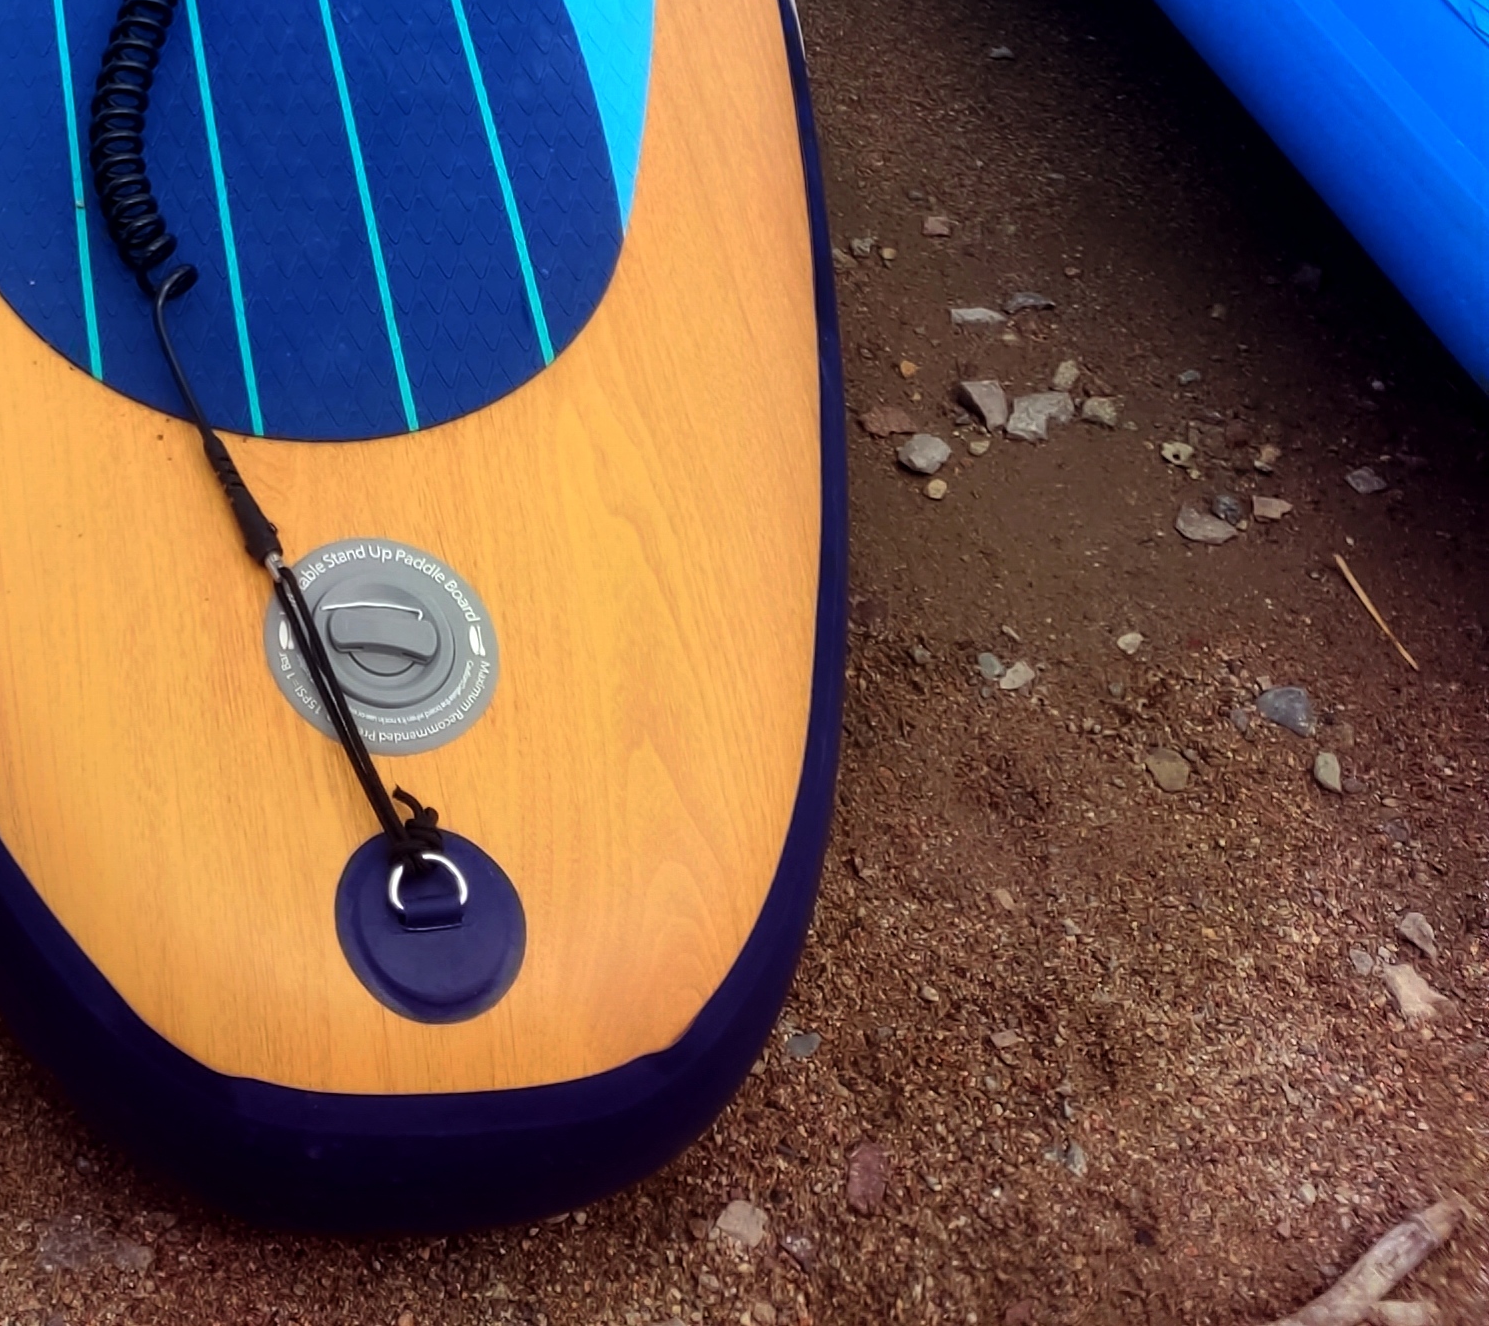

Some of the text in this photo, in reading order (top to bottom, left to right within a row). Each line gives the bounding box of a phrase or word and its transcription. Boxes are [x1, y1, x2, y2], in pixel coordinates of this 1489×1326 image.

[322, 544, 367, 569] Stand
[368, 544, 392, 564] Up
[395, 549, 446, 584] Paddle
[444, 579, 481, 622] Board
[278, 651, 292, 672] Bar
[460, 660, 491, 712] Maximum
[378, 708, 465, 744] Recommended
